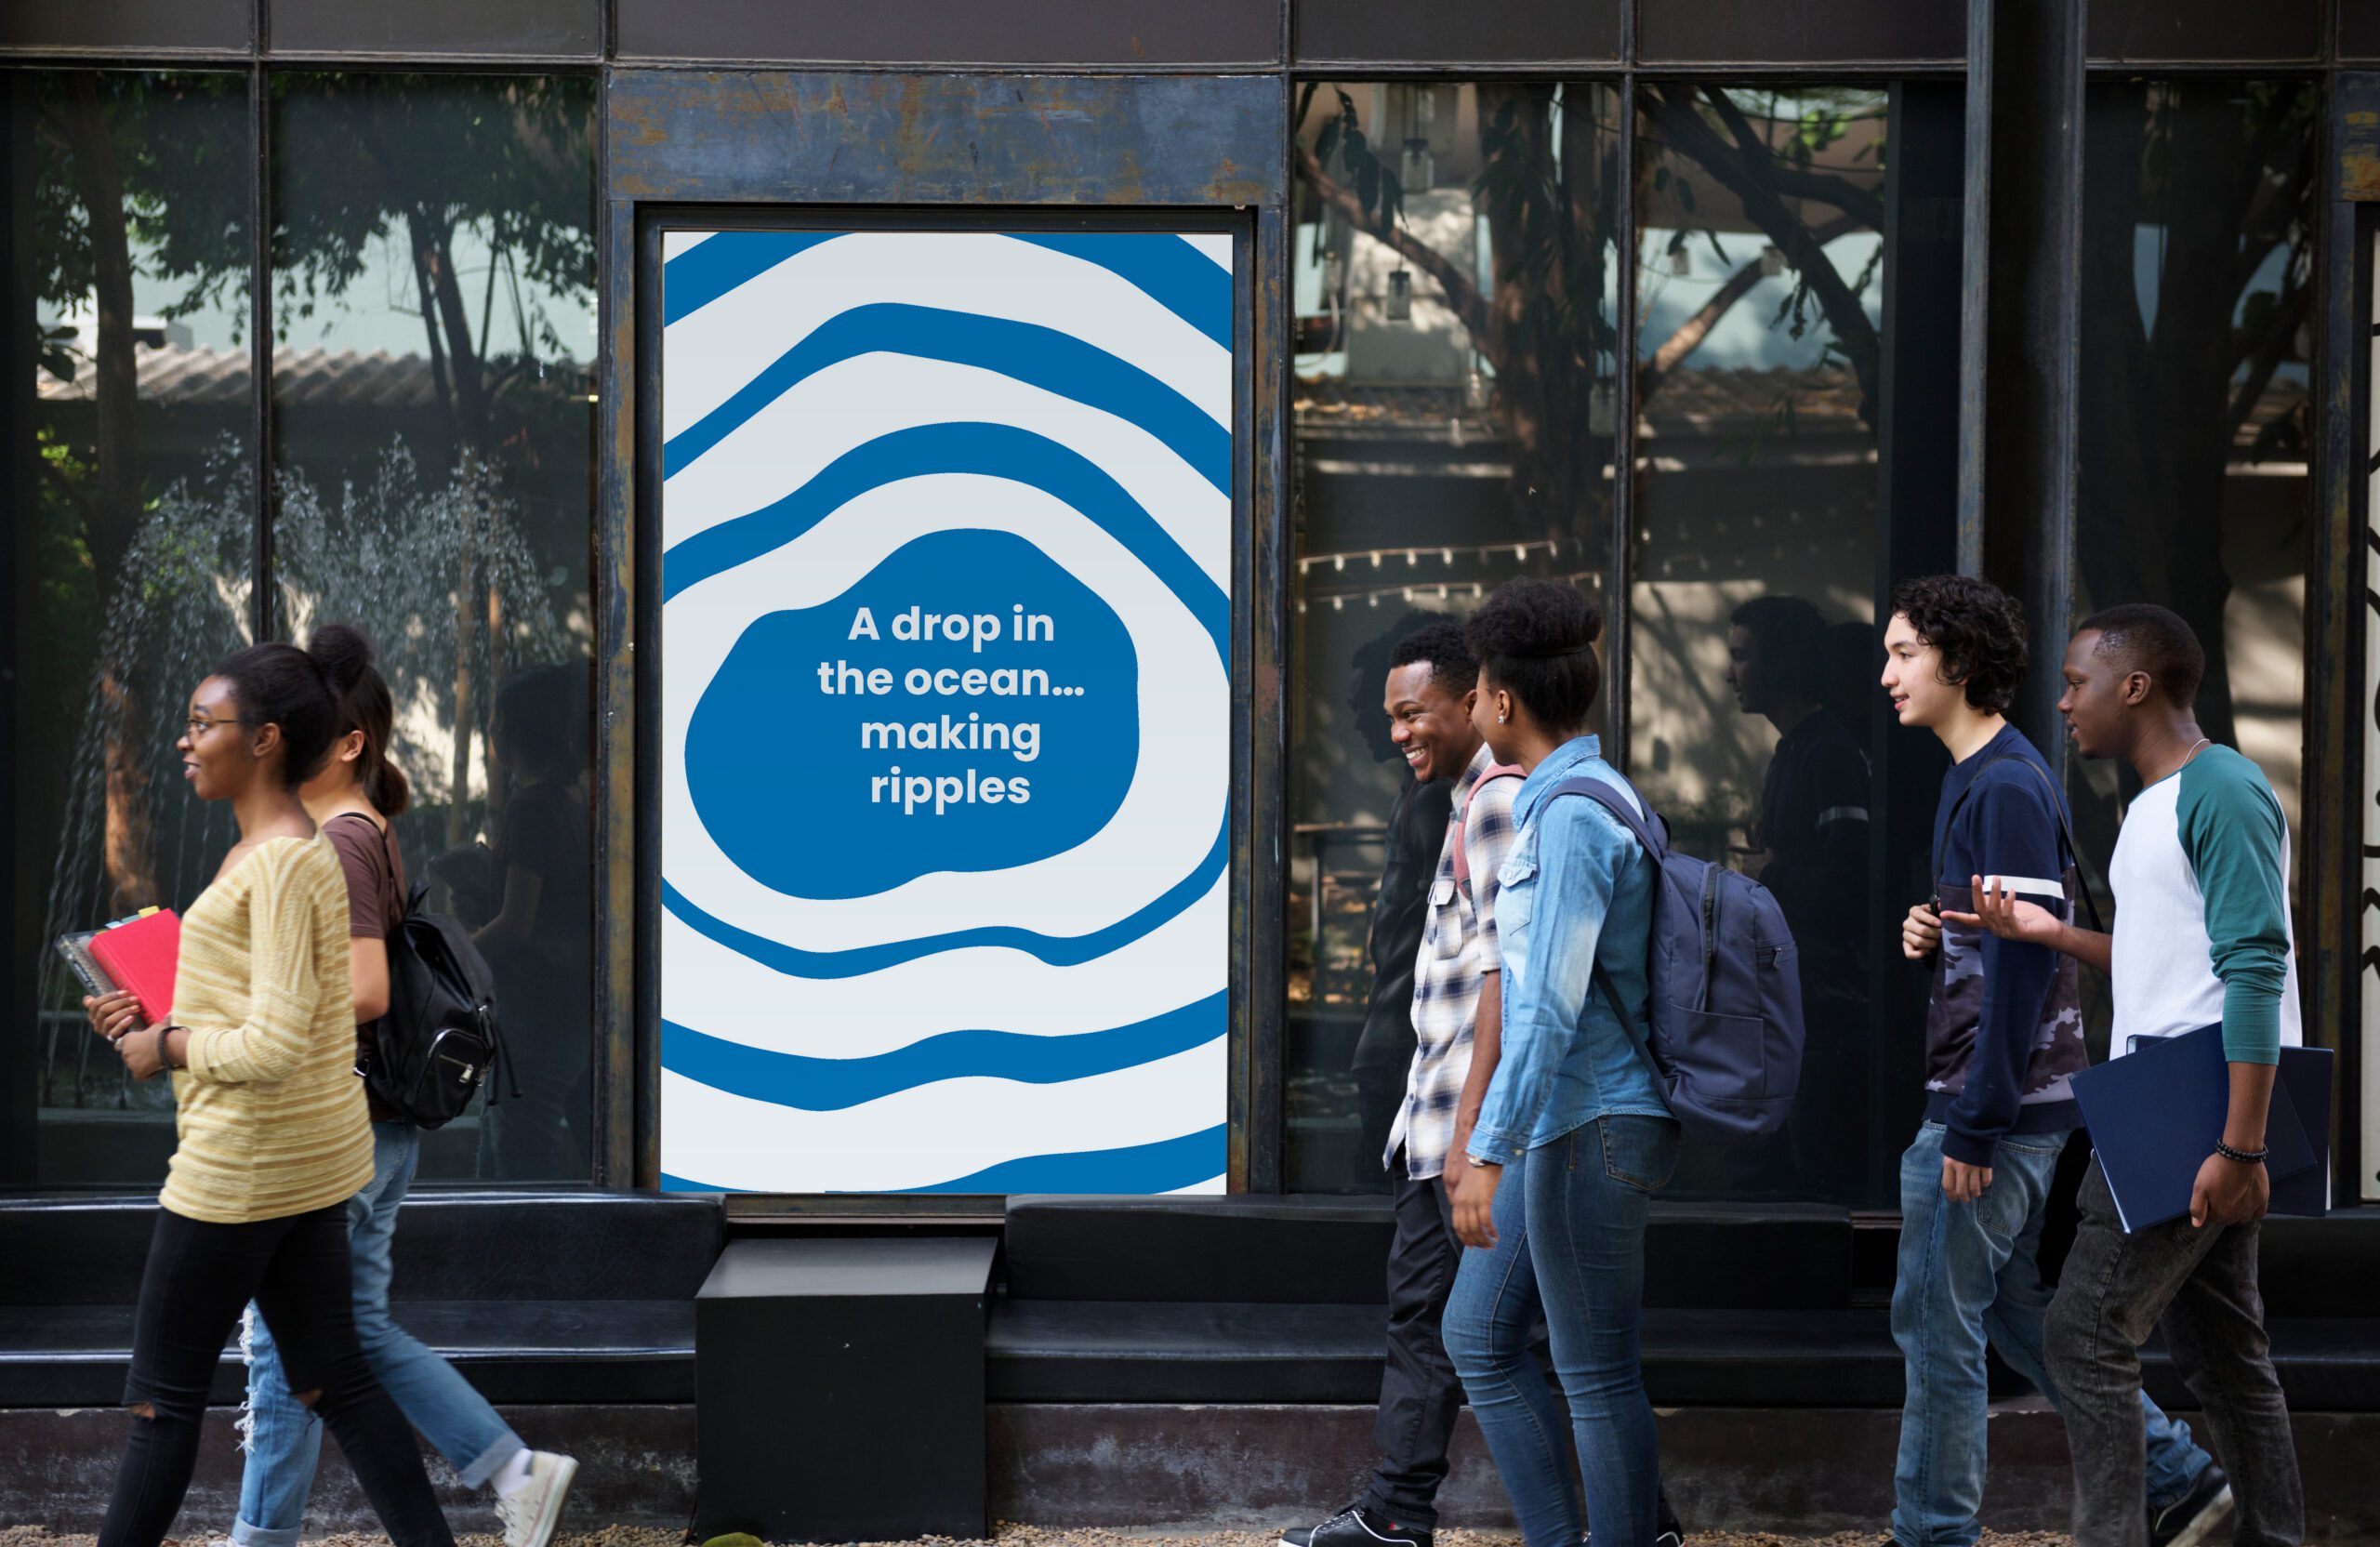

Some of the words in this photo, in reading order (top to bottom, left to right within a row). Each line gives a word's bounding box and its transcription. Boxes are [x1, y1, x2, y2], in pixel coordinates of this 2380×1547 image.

[847, 607, 881, 641] A
[892, 605, 1001, 654] drop
[1012, 603, 1054, 641] in
[817, 660, 893, 695] the
[904, 668, 1085, 696] ocean...
[862, 712, 1040, 762] making
[871, 765, 1031, 815] ripples
